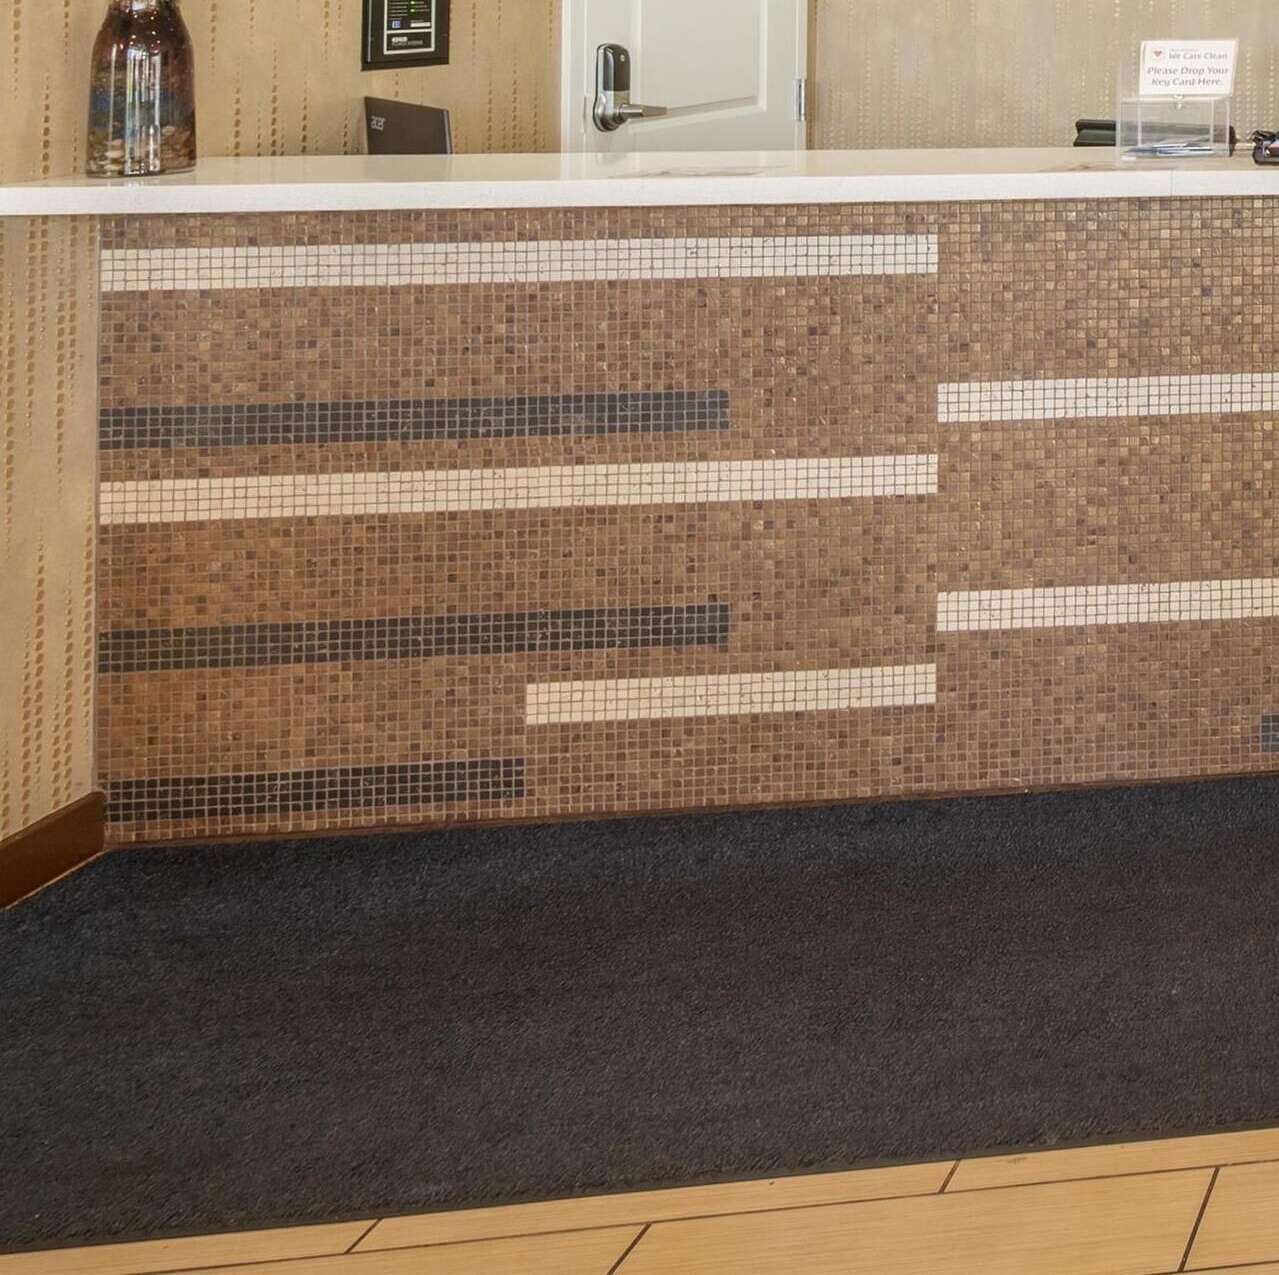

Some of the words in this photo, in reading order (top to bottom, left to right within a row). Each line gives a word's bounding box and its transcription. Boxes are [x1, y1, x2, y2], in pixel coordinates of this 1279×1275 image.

[1204, 52, 1228, 60] Clean
[1147, 66, 1178, 75] Please
[1180, 66, 1204, 76] Drop
[1206, 66, 1229, 75] Your
[1151, 78, 1170, 86] Key
[1172, 78, 1195, 86] Card
